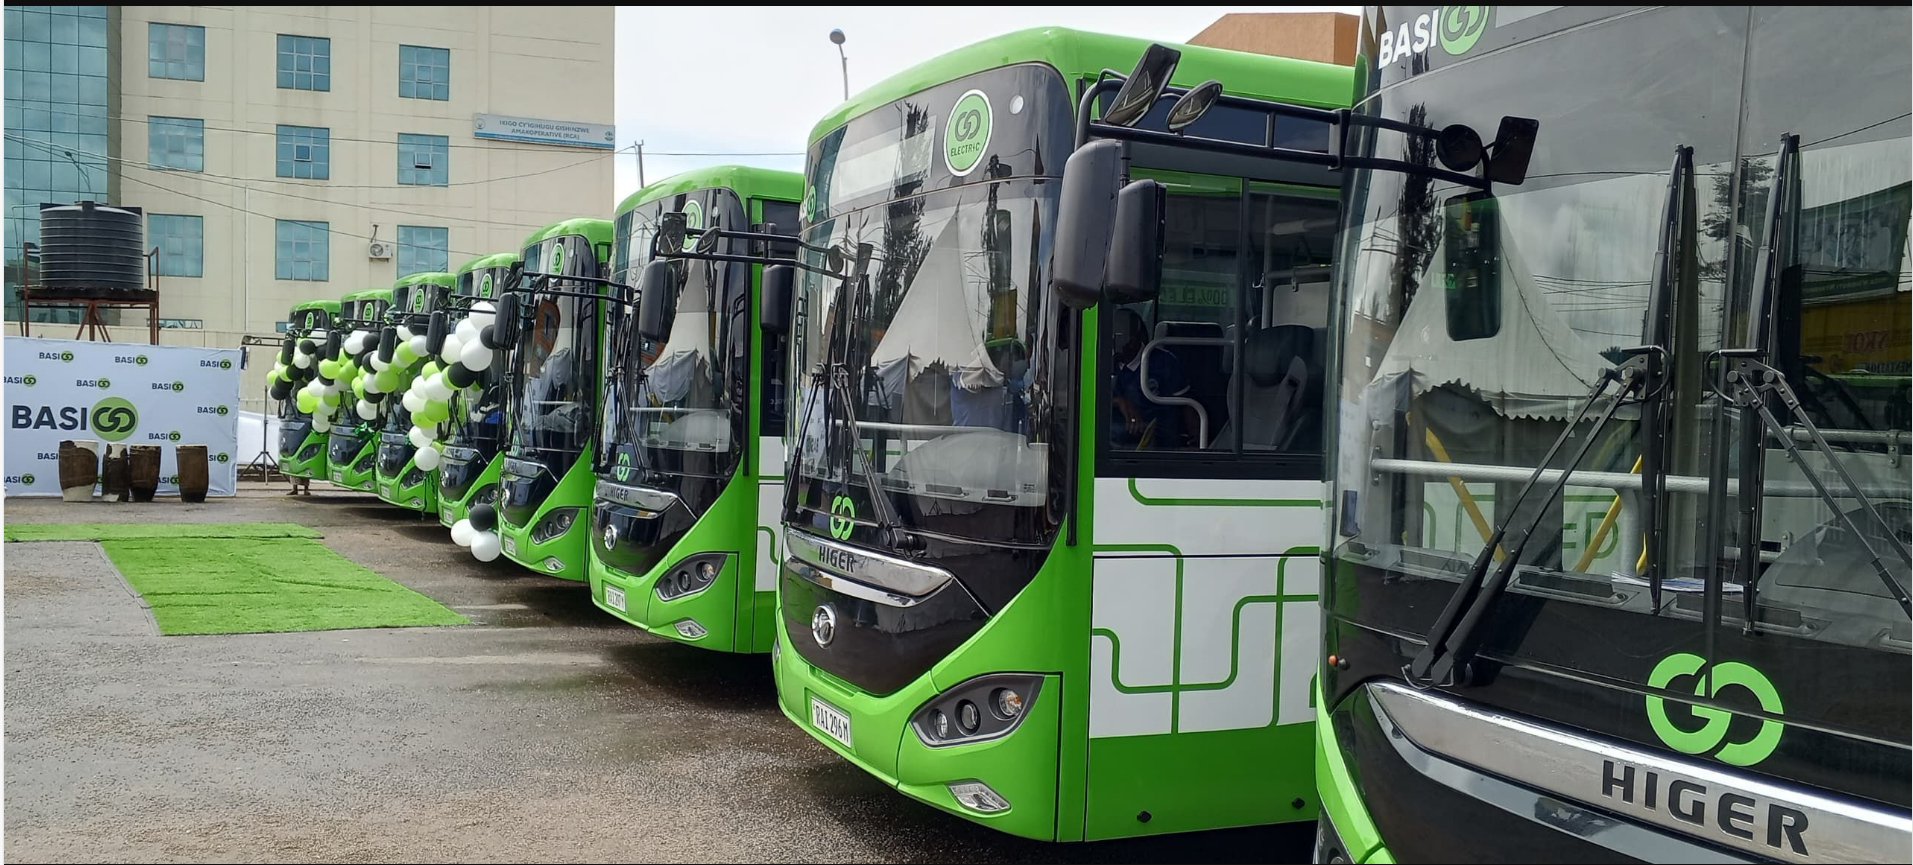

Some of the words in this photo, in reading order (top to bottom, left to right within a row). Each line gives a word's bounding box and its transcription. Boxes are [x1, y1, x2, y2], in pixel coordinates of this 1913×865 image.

[511, 128, 562, 138] AMAKOPERATIVE
[818, 545, 855, 573] HIGER
[1602, 759, 1810, 858] HIGER
